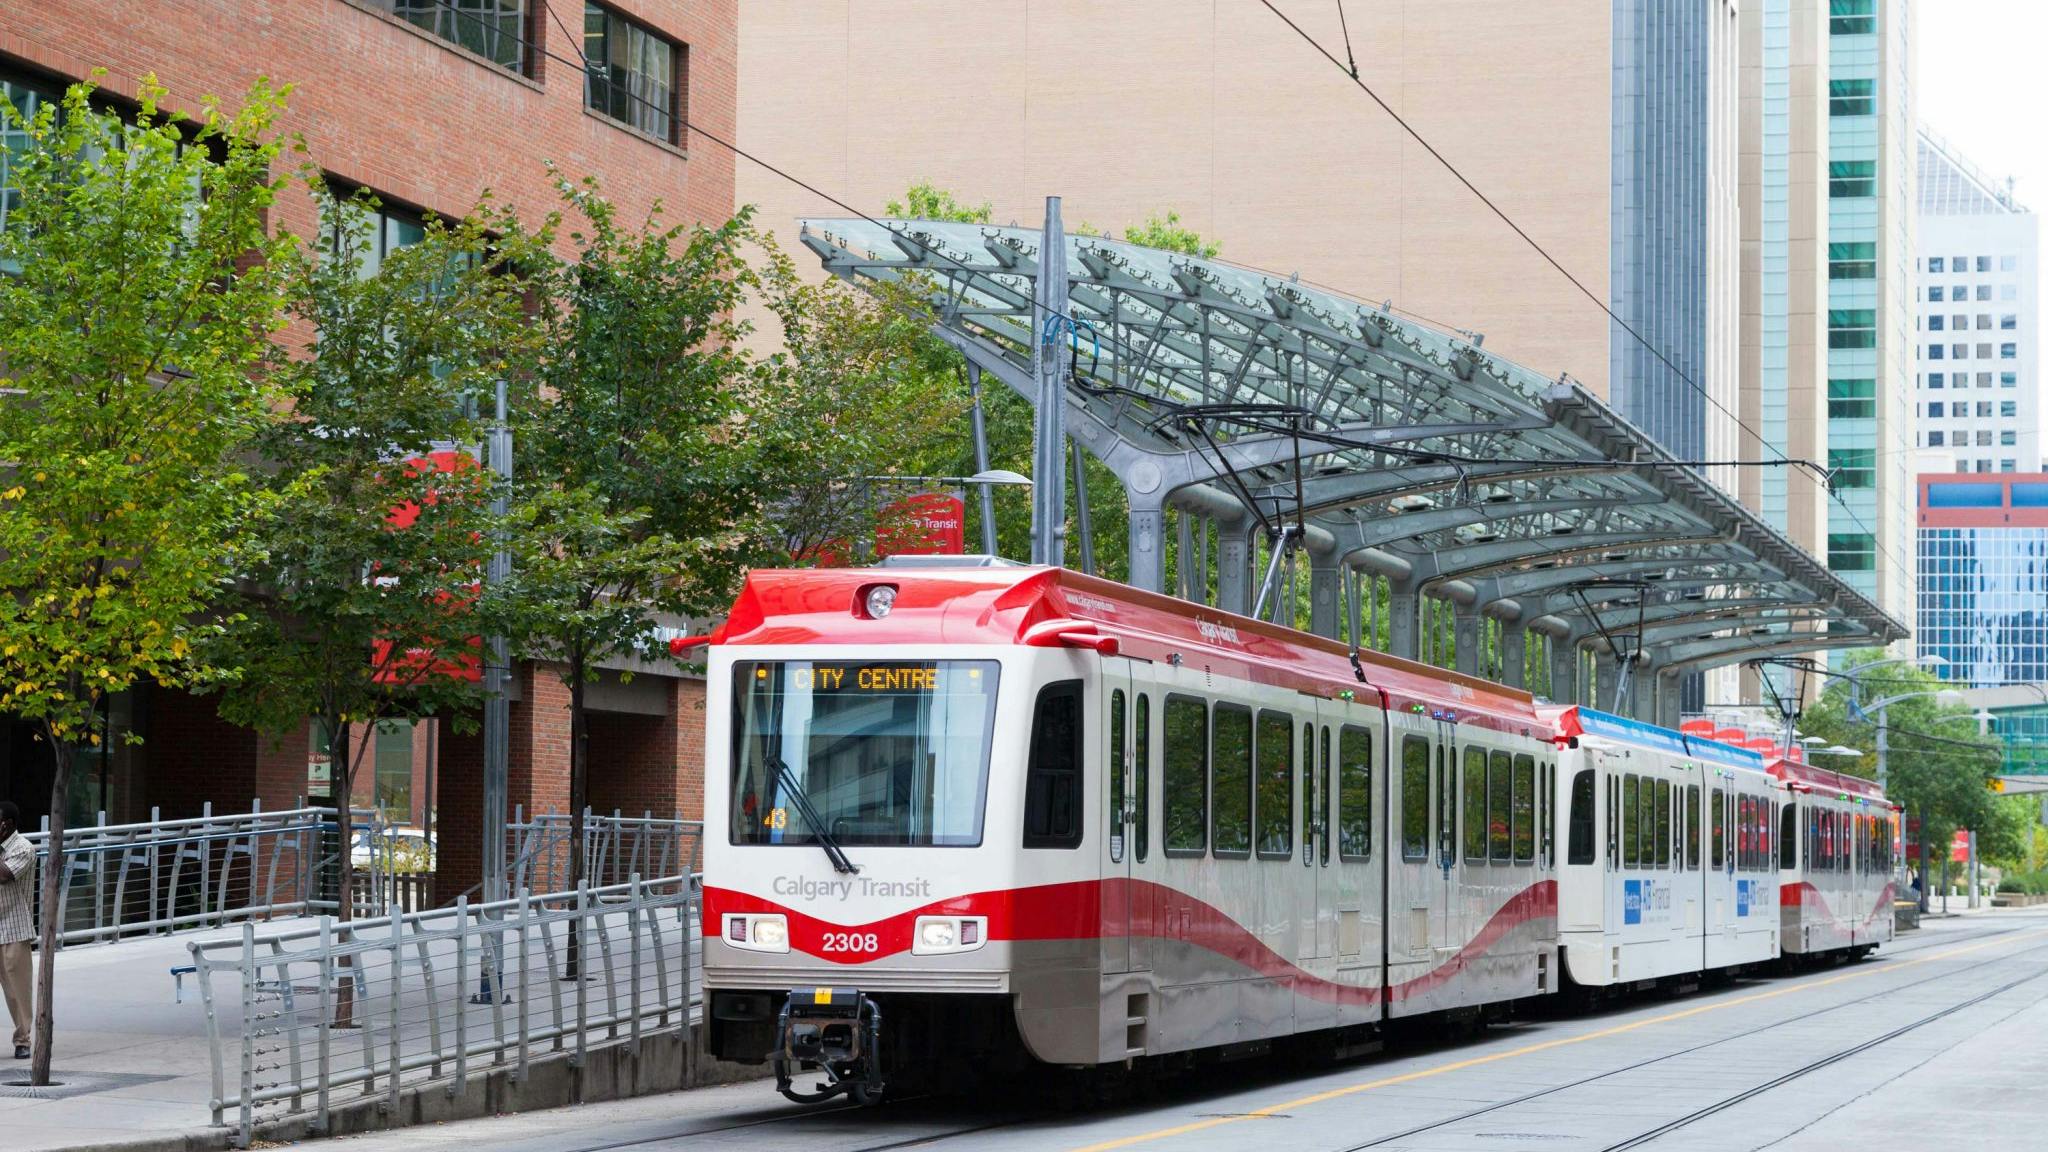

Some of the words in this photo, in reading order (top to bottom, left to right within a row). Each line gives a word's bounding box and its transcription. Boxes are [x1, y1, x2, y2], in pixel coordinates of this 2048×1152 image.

[925, 519, 958, 529] Transit
[794, 668, 844, 689] CITY
[858, 668, 940, 689] CENTRE
[772, 875, 852, 902] Calgary
[859, 877, 931, 897] Transit
[822, 932, 879, 953] 2308
